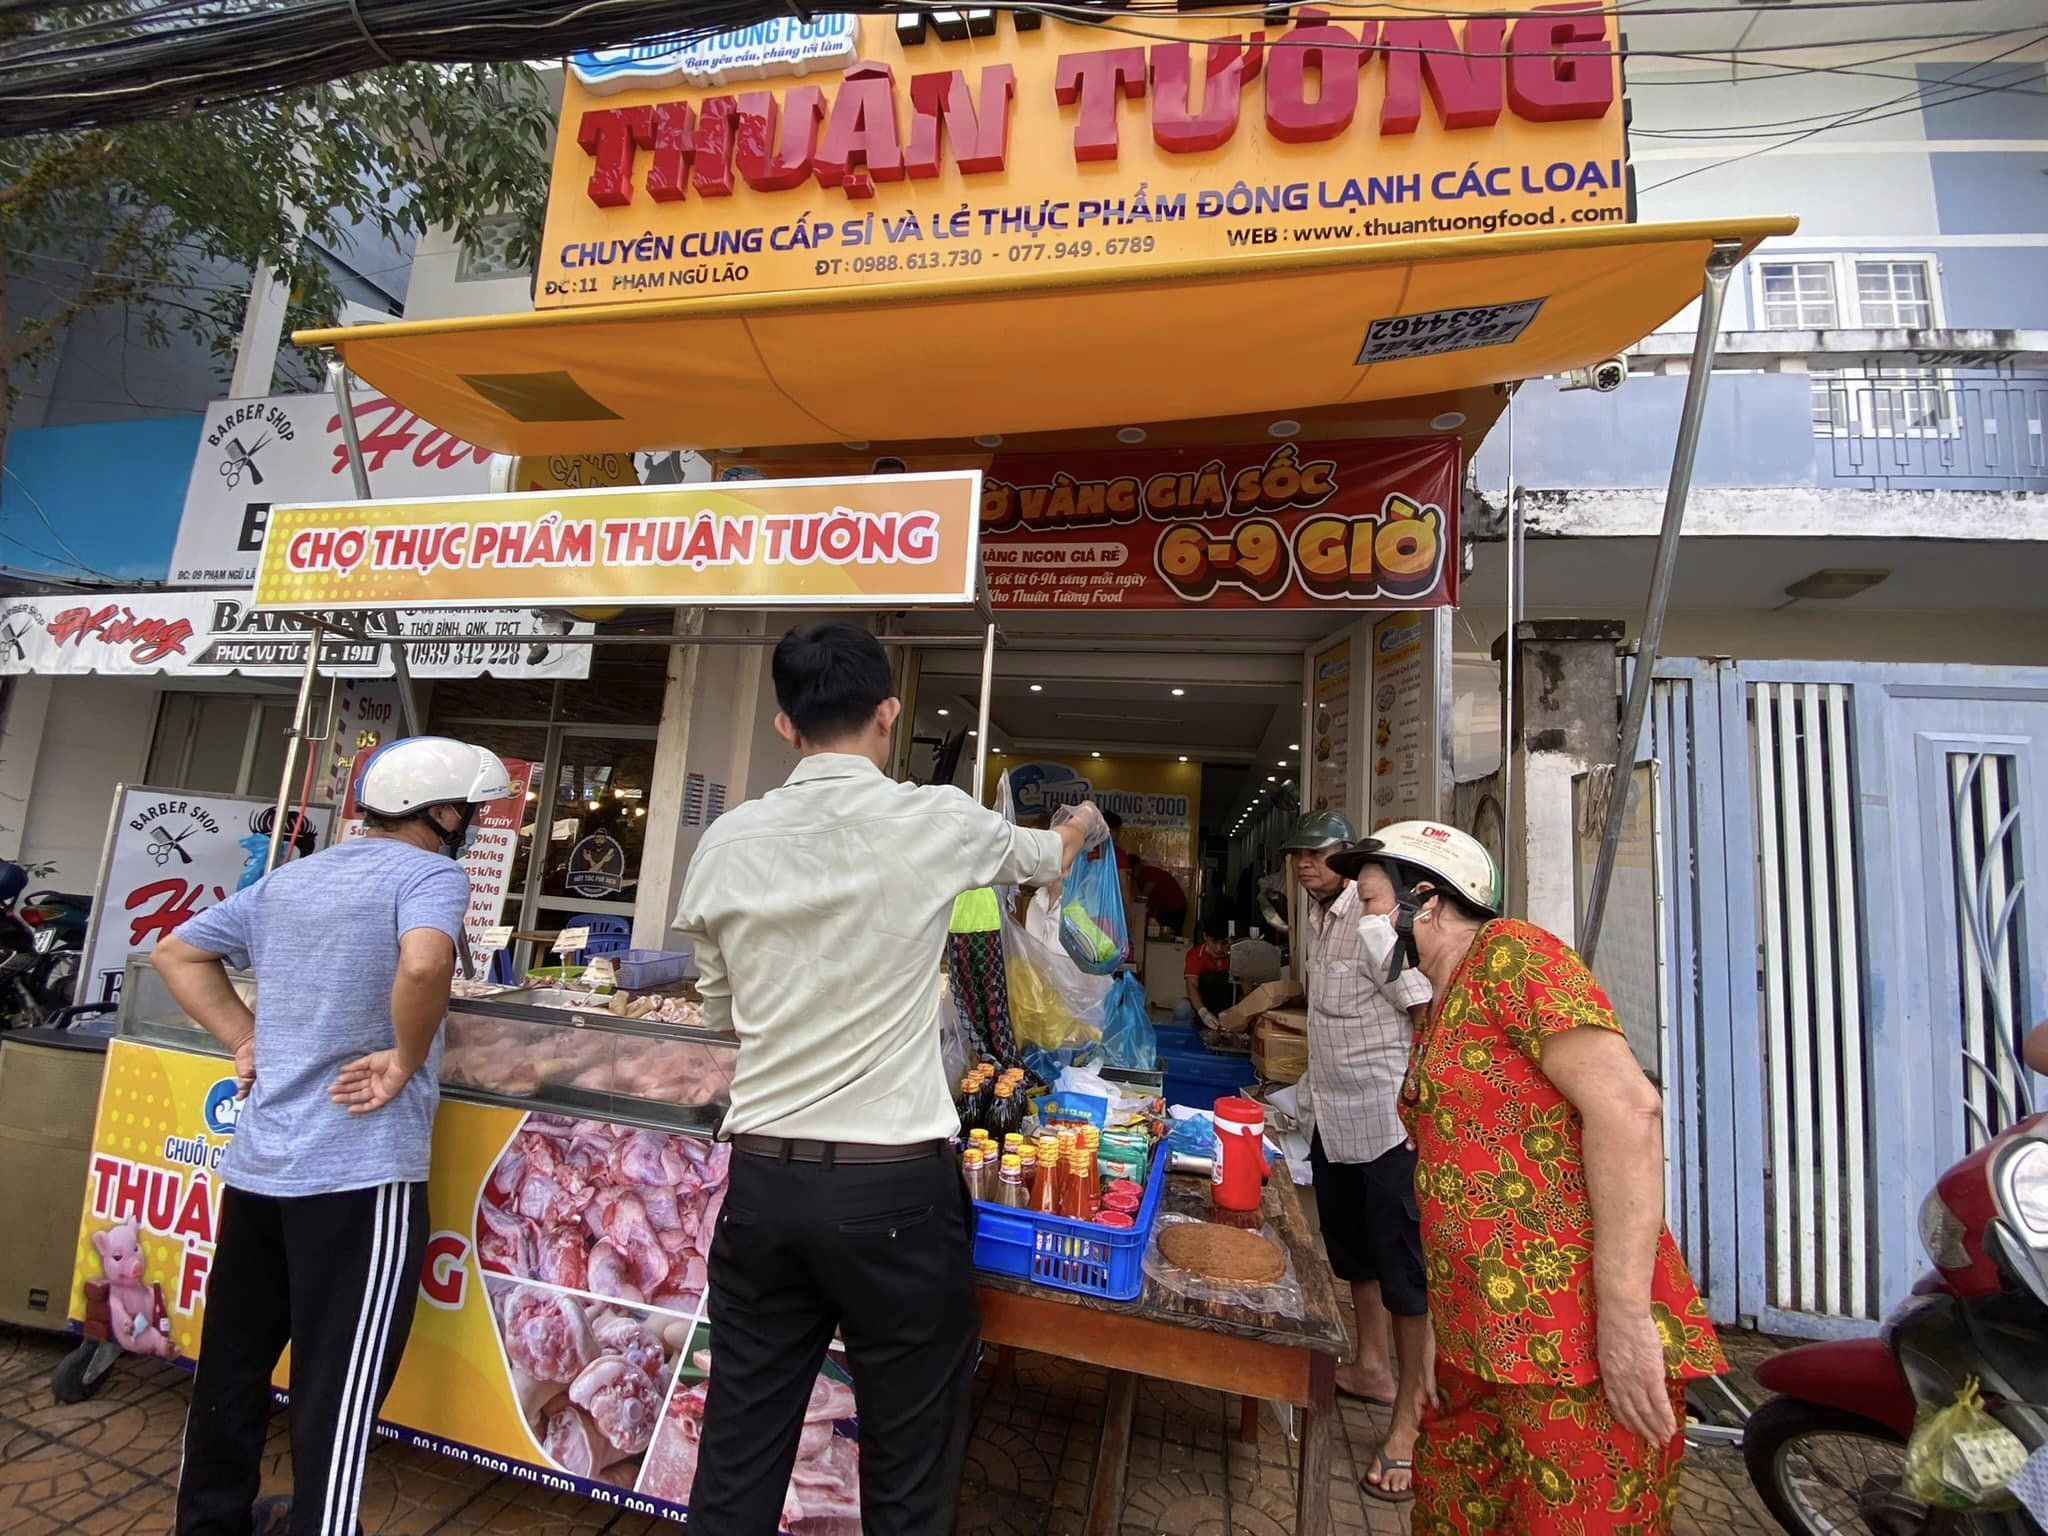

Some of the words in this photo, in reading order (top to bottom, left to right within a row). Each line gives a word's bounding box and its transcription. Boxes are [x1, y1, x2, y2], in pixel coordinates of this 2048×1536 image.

[685, 57, 709, 70] Bạn
[710, 53, 732, 68] yêu
[820, 40, 844, 53] làm
[577, 60, 1017, 208] THUẬN
[1055, 3, 1613, 162] TƯỜNG
[560, 231, 674, 268] CHUYÊN
[680, 227, 763, 258] CUNG
[770, 211, 833, 250] CẤP
[841, 211, 874, 246] SỈ
[882, 209, 924, 243] VÀ
[932, 203, 971, 239] LẺ
[978, 199, 1070, 238] THỰC
[1077, 182, 1186, 228] PHẨM
[1196, 180, 1308, 219] ĐÔNG
[1318, 173, 1421, 214] LẠNH
[1431, 161, 1511, 199] CÁC
[1521, 158, 1621, 198] LOẠI
[1008, 235, 1156, 263] 077.949.6789
[612, 271, 665, 293] PHẠM
[668, 264, 710, 286] NGŨ
[712, 264, 749, 284] LÃO
[208, 402, 265, 448] BARBER
[266, 404, 295, 442] SHOP
[1019, 474, 1142, 521] VÀNG
[1147, 463, 1228, 512] GIÁ
[1234, 445, 1336, 505] SỐC
[290, 528, 366, 574] CHỢ
[374, 526, 466, 572] THỰC
[471, 513, 592, 565] PHẨM
[606, 512, 753, 571] THUẬN
[763, 509, 938, 562] TƯỜNG
[1022, 550, 1066, 563] NGON
[1071, 548, 1096, 563] GIÁ
[1101, 545, 1121, 562] RẺ
[1159, 525, 1284, 588] 6-9
[1297, 498, 1441, 590] GIỜ
[245, 567, 257, 580] LÃ
[994, 572, 1012, 586] sốc
[1014, 572, 1028, 586] từ
[1029, 571, 1057, 586] 6-9h
[1059, 573, 1088, 588] sáng
[1090, 571, 1114, 586] mỗi
[1116, 573, 1148, 588] ngày
[1012, 589, 1050, 605] Thuận
[1053, 589, 1089, 606] Tường
[1092, 589, 1124, 603] Food
[496, 621, 521, 637] TPCT
[216, 645, 256, 663] PHỤC
[257, 645, 276, 663] VỤ
[411, 642, 450, 665] 0939
[454, 642, 484, 665] 342
[488, 642, 521, 665] 228
[358, 696, 392, 724] Shop
[129, 800, 188, 832] BARBER
[190, 806, 219, 835] SHOP
[165, 1135, 208, 1167] CHUỖI
[94, 1157, 223, 1248] THUẬ
